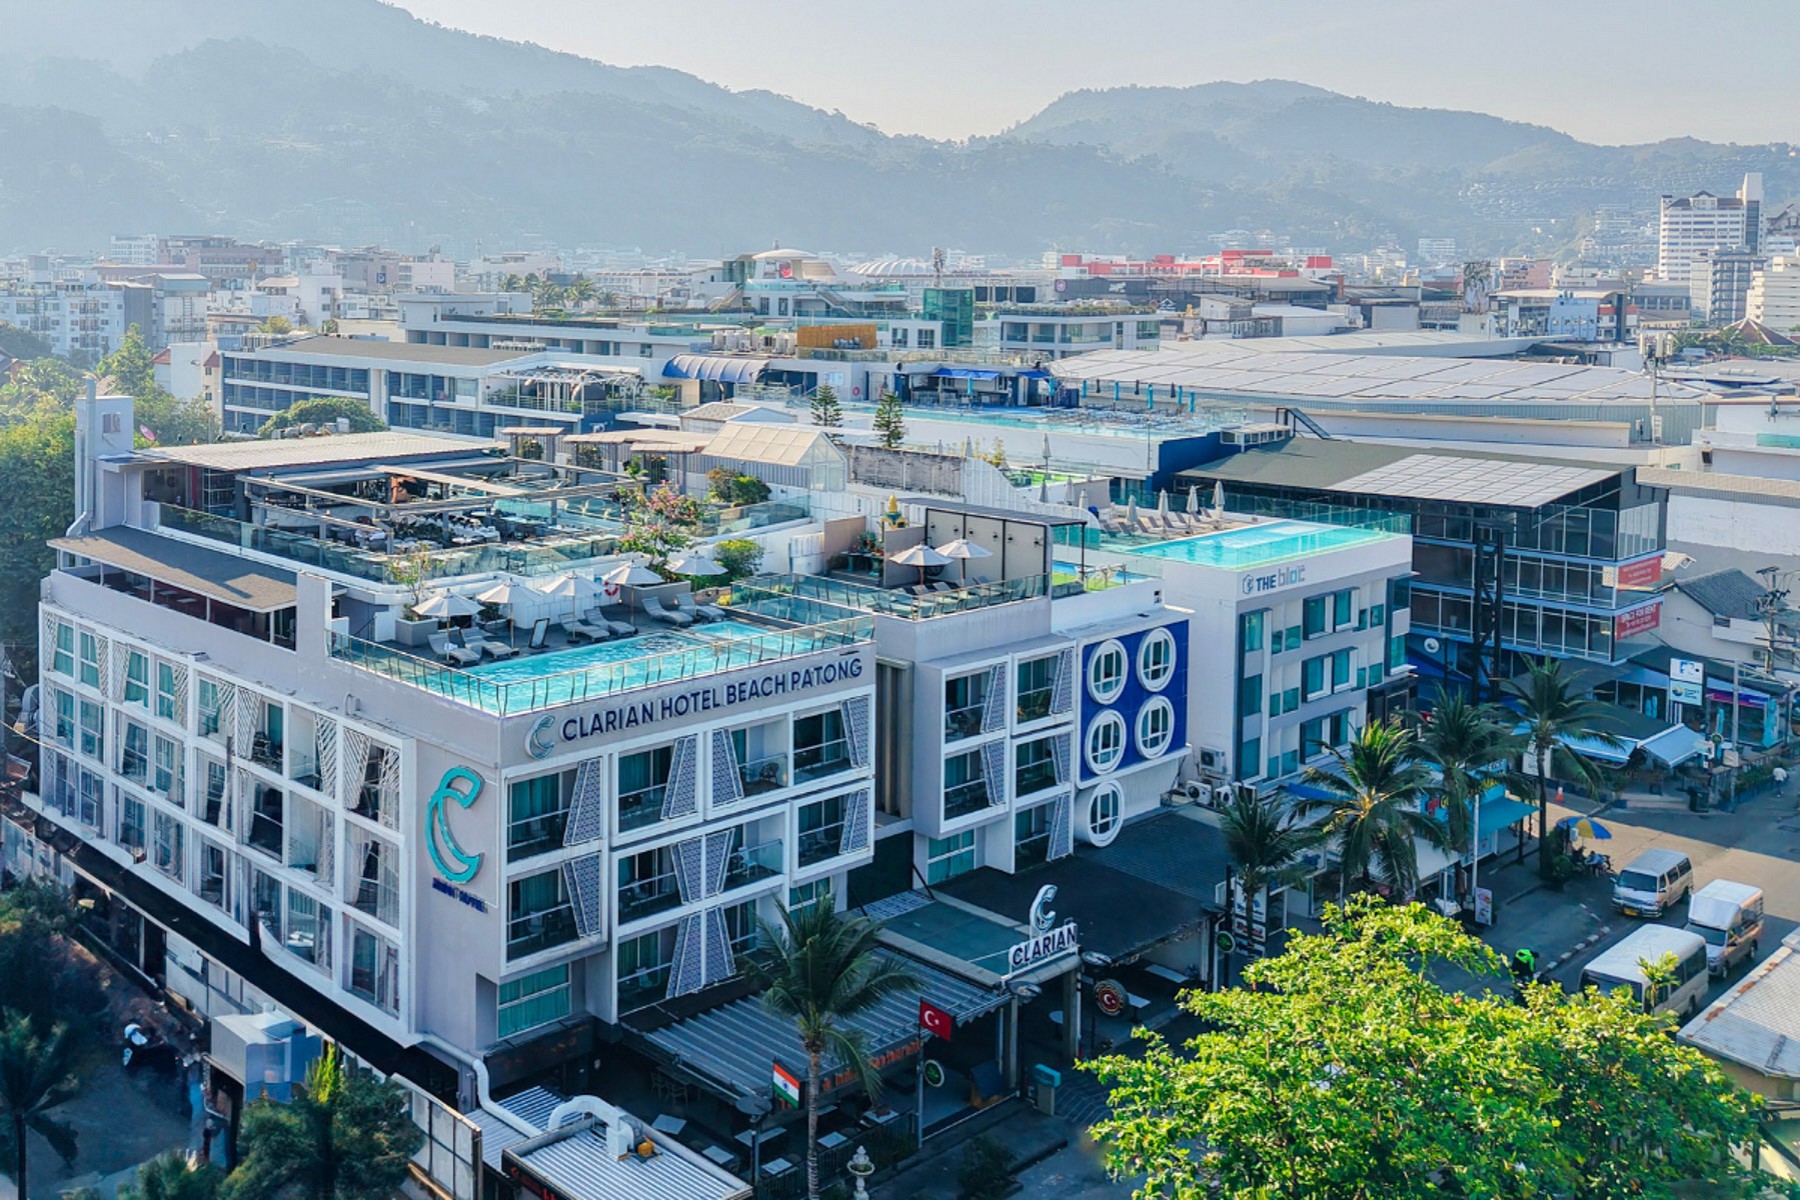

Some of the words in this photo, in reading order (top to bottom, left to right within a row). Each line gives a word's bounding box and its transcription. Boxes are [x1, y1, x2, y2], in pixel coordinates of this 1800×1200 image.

[1256, 574, 1277, 591] THE
[561, 701, 655, 742] CLARIAN
[660, 690, 721, 721] HOTEL
[726, 675, 786, 706] BEACH
[790, 657, 864, 690] PATONG
[1012, 927, 1077, 966] CLARIAN
